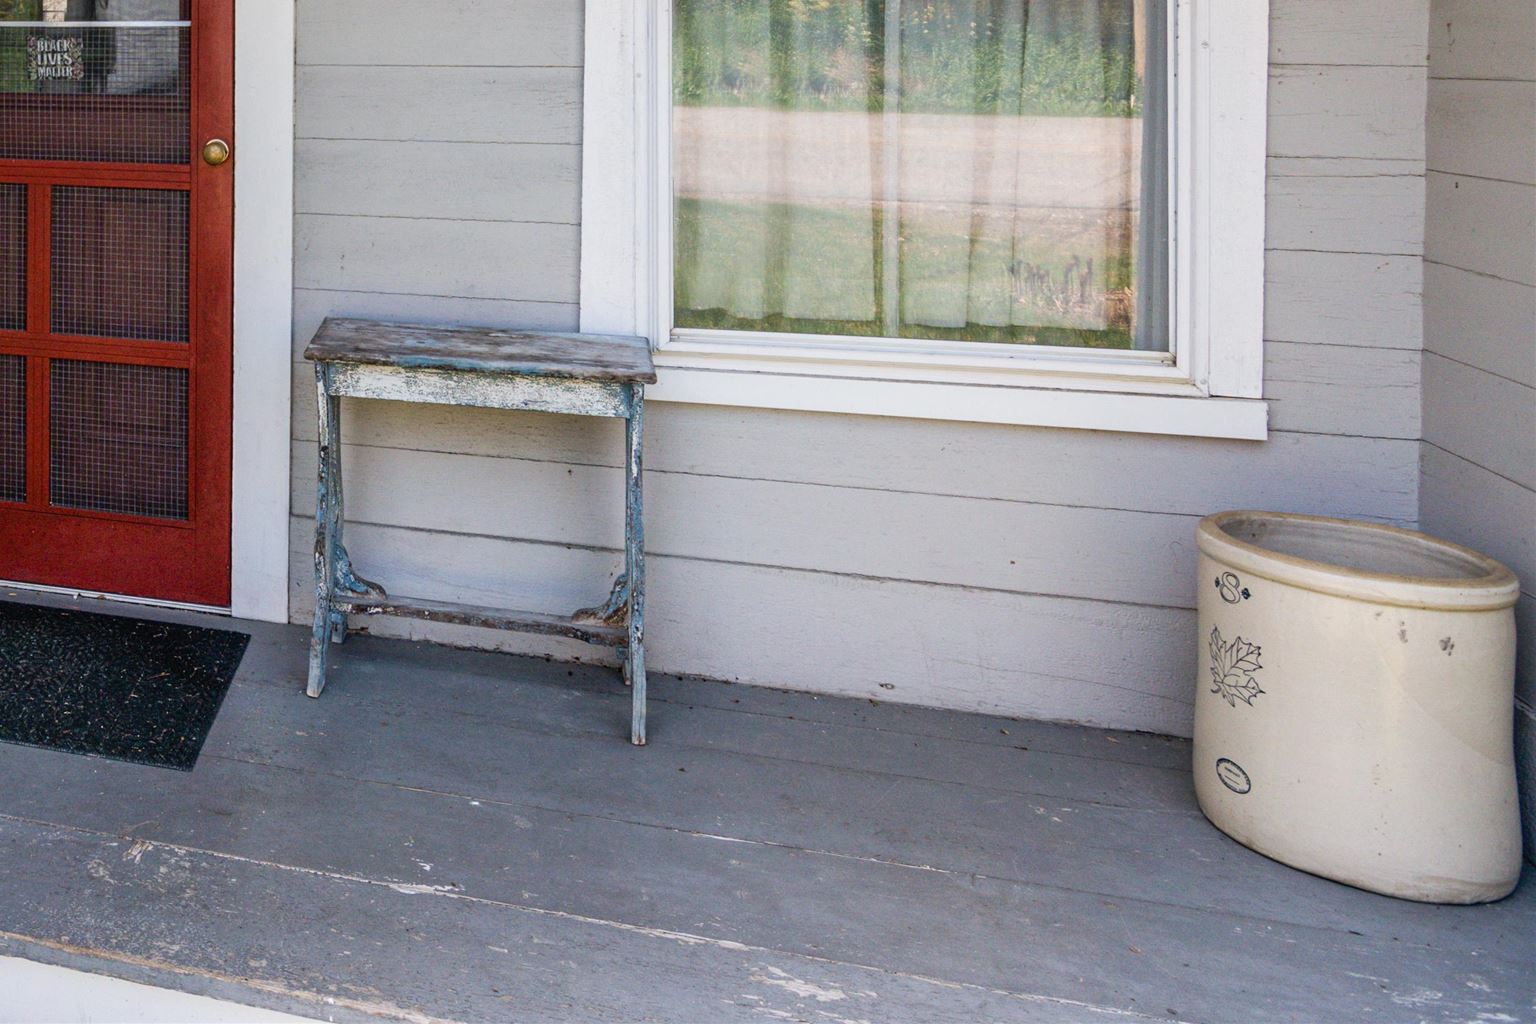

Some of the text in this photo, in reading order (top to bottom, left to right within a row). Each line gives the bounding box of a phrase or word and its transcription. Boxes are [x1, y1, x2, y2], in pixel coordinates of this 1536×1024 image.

[37, 39, 70, 51] BLACK
[37, 52, 73, 65] LIVES
[37, 66, 73, 78] MATTER
[1219, 571, 1241, 604] 8
